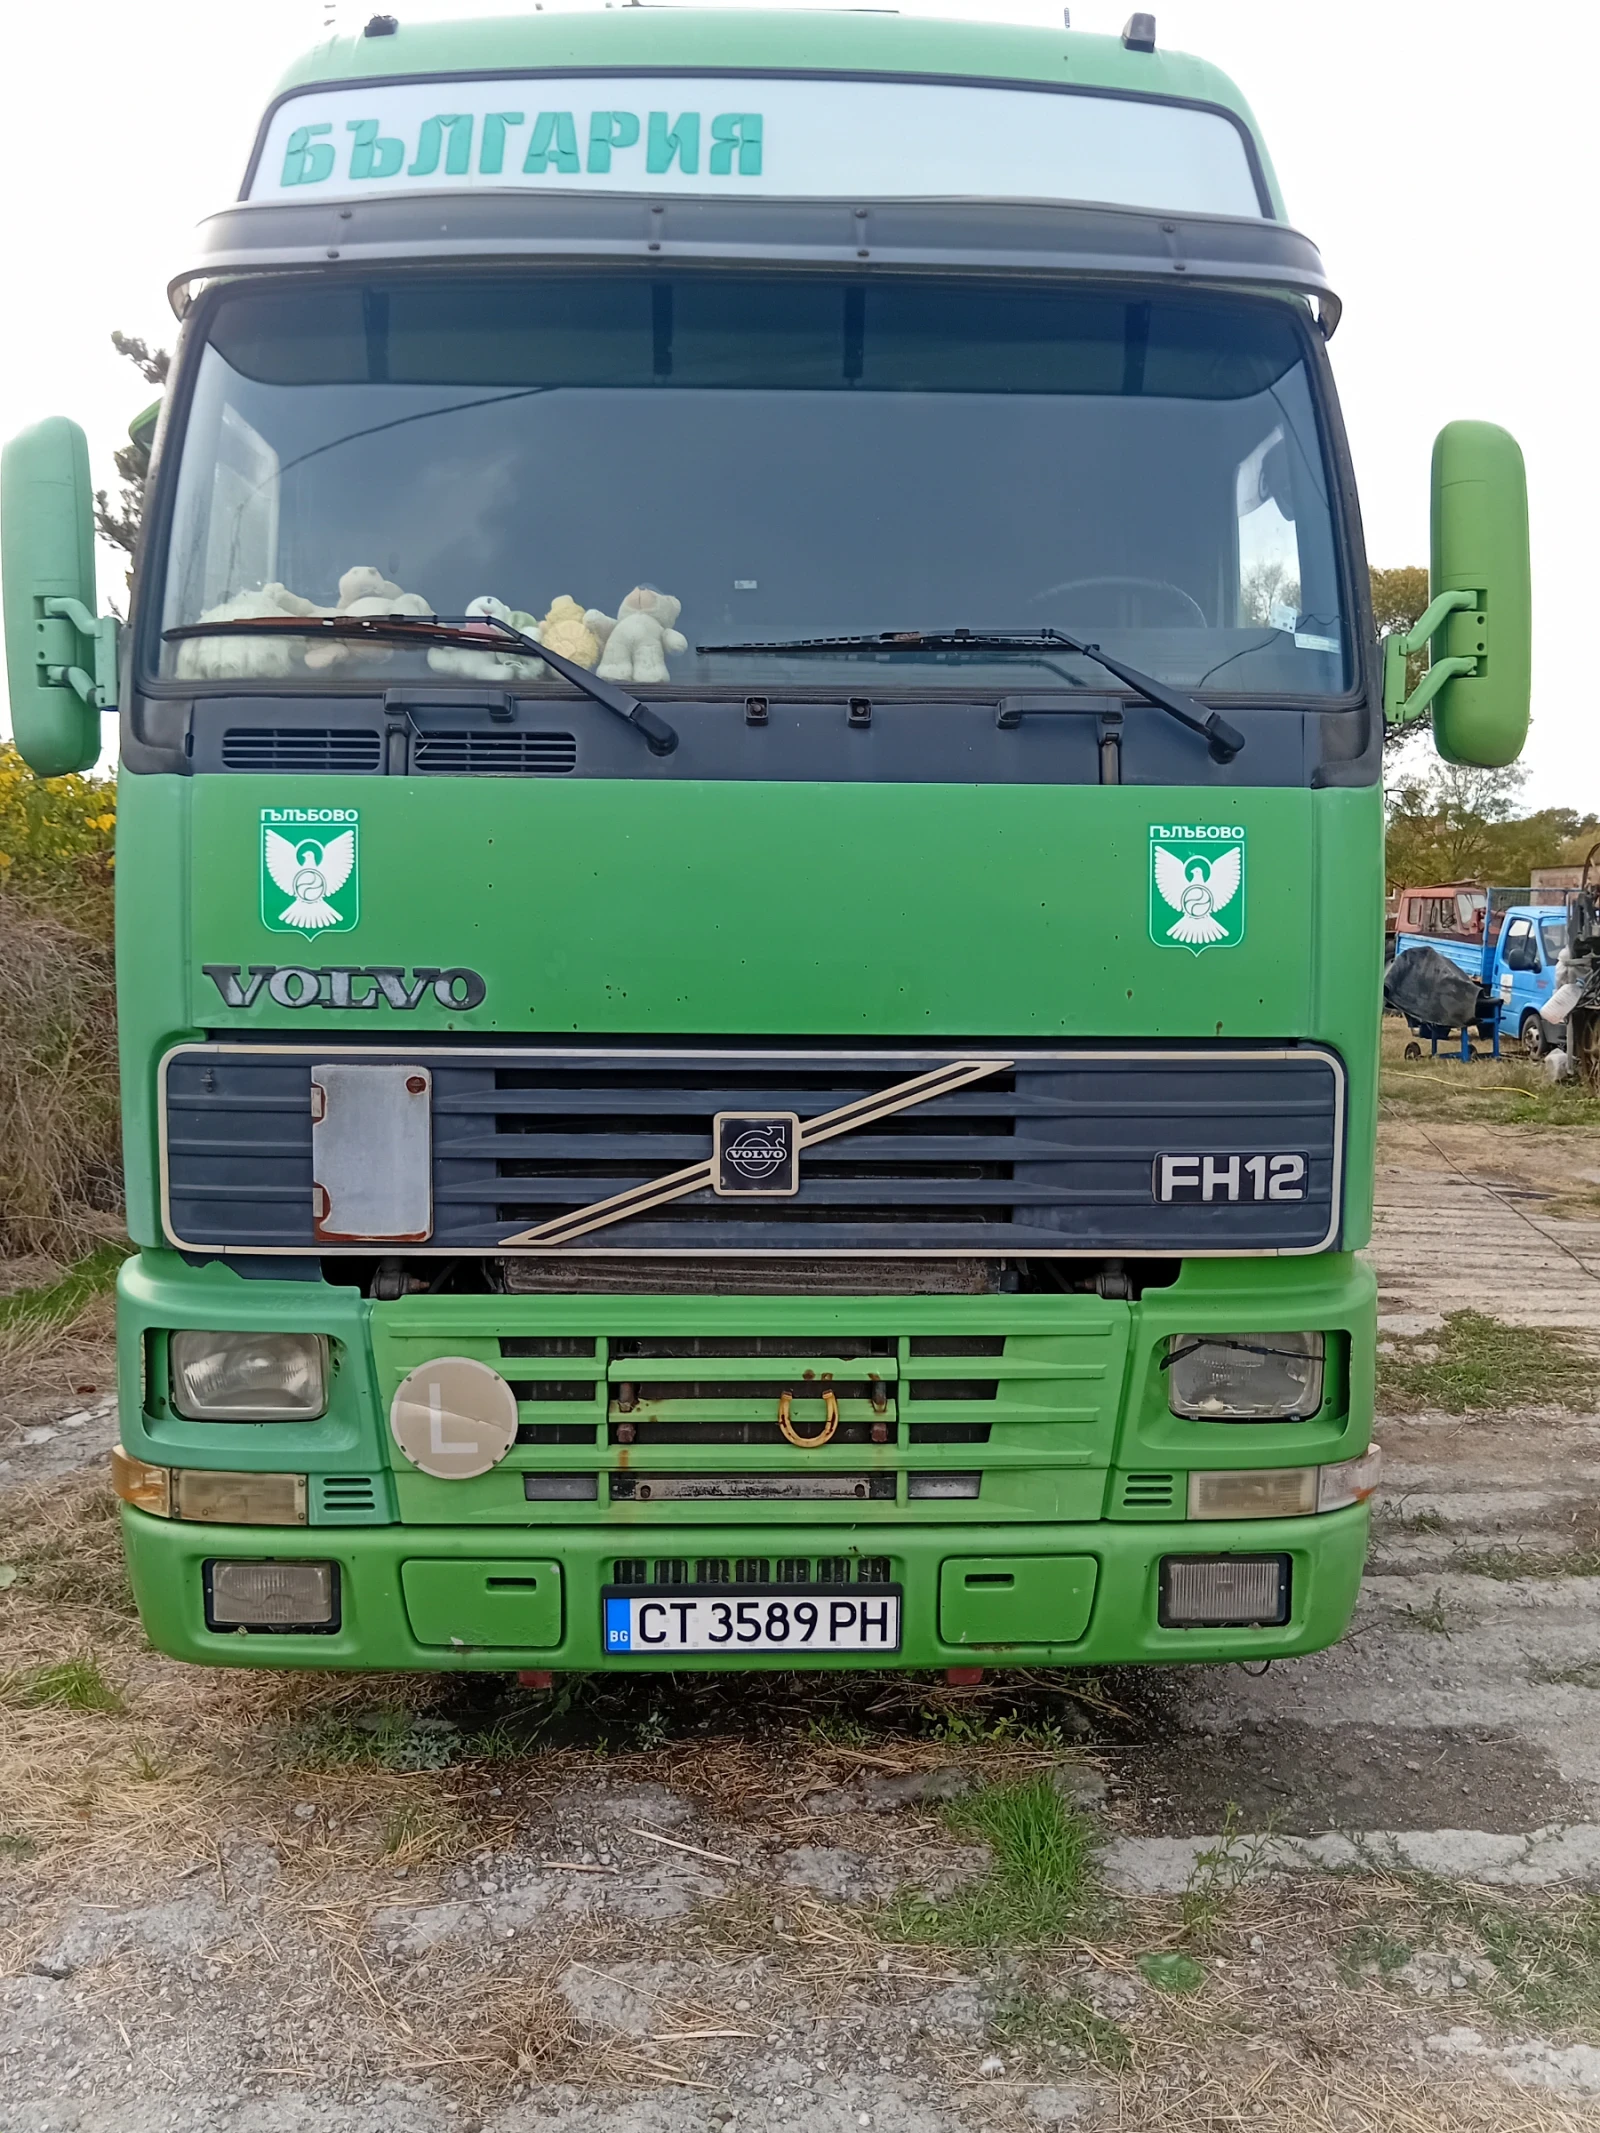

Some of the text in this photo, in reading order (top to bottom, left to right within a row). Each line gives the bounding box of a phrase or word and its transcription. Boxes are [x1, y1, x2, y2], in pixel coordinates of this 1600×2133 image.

[281, 112, 763, 187] БЪЛГАРИЯ
[260, 808, 359, 822] ГЪЛЪБОВО
[1149, 825, 1245, 839] ГЪЛЪБОВО
[202, 965, 486, 1011] VOLVO
[729, 1150, 783, 1159] VOLVO
[1161, 1155, 1304, 1201] FH12
[429, 1383, 478, 1454] L
[610, 1630, 628, 1642] BG
[708, 1602, 818, 1642] 3589
